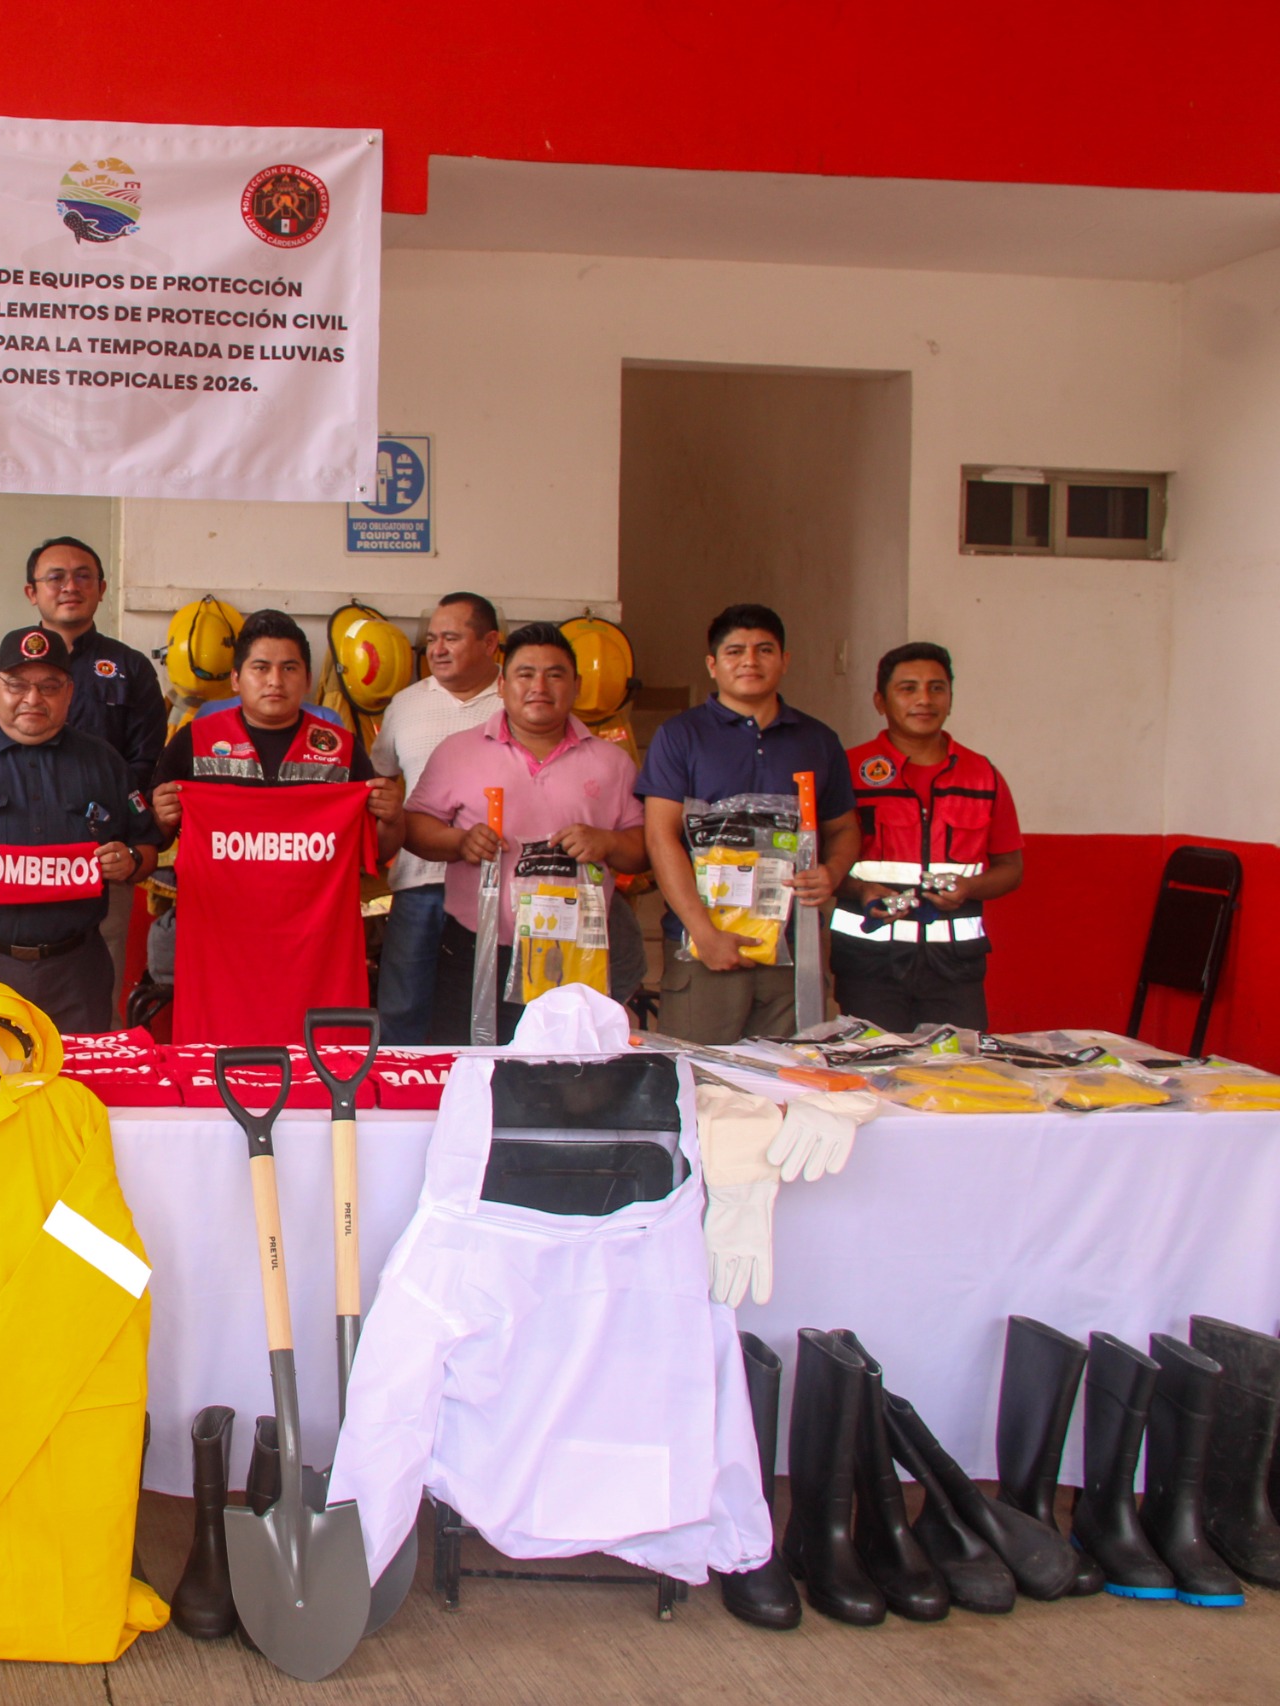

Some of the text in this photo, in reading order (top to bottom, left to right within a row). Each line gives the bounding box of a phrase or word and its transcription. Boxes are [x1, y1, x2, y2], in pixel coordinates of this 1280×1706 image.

[280, 166, 293, 174] DE
[294, 168, 328, 207] BOMBEROS
[29, 271, 124, 289] EQUIPOS
[130, 275, 157, 290] DE
[163, 276, 302, 297] PROTECCIÓN
[114, 306, 142, 322] DE
[147, 307, 287, 329] PROTECCIÓN
[292, 313, 348, 330] CIVIL
[56, 336, 82, 353] LA
[87, 338, 223, 359] TEMPORADA
[228, 344, 254, 360] DE
[260, 345, 345, 363] LLUVIAS
[66, 369, 198, 390] TROPICALES
[202, 375, 259, 392] 2026.
[352, 522, 424, 531] USO OBLIGATORIO DE
[360, 531, 417, 540] EQUIPO DE
[356, 541, 421, 549] PROTECCION
[212, 831, 336, 862] BOMBEROS
[344, 1202, 352, 1236] PRETUL
[269, 1236, 278, 1270] PRETUL
